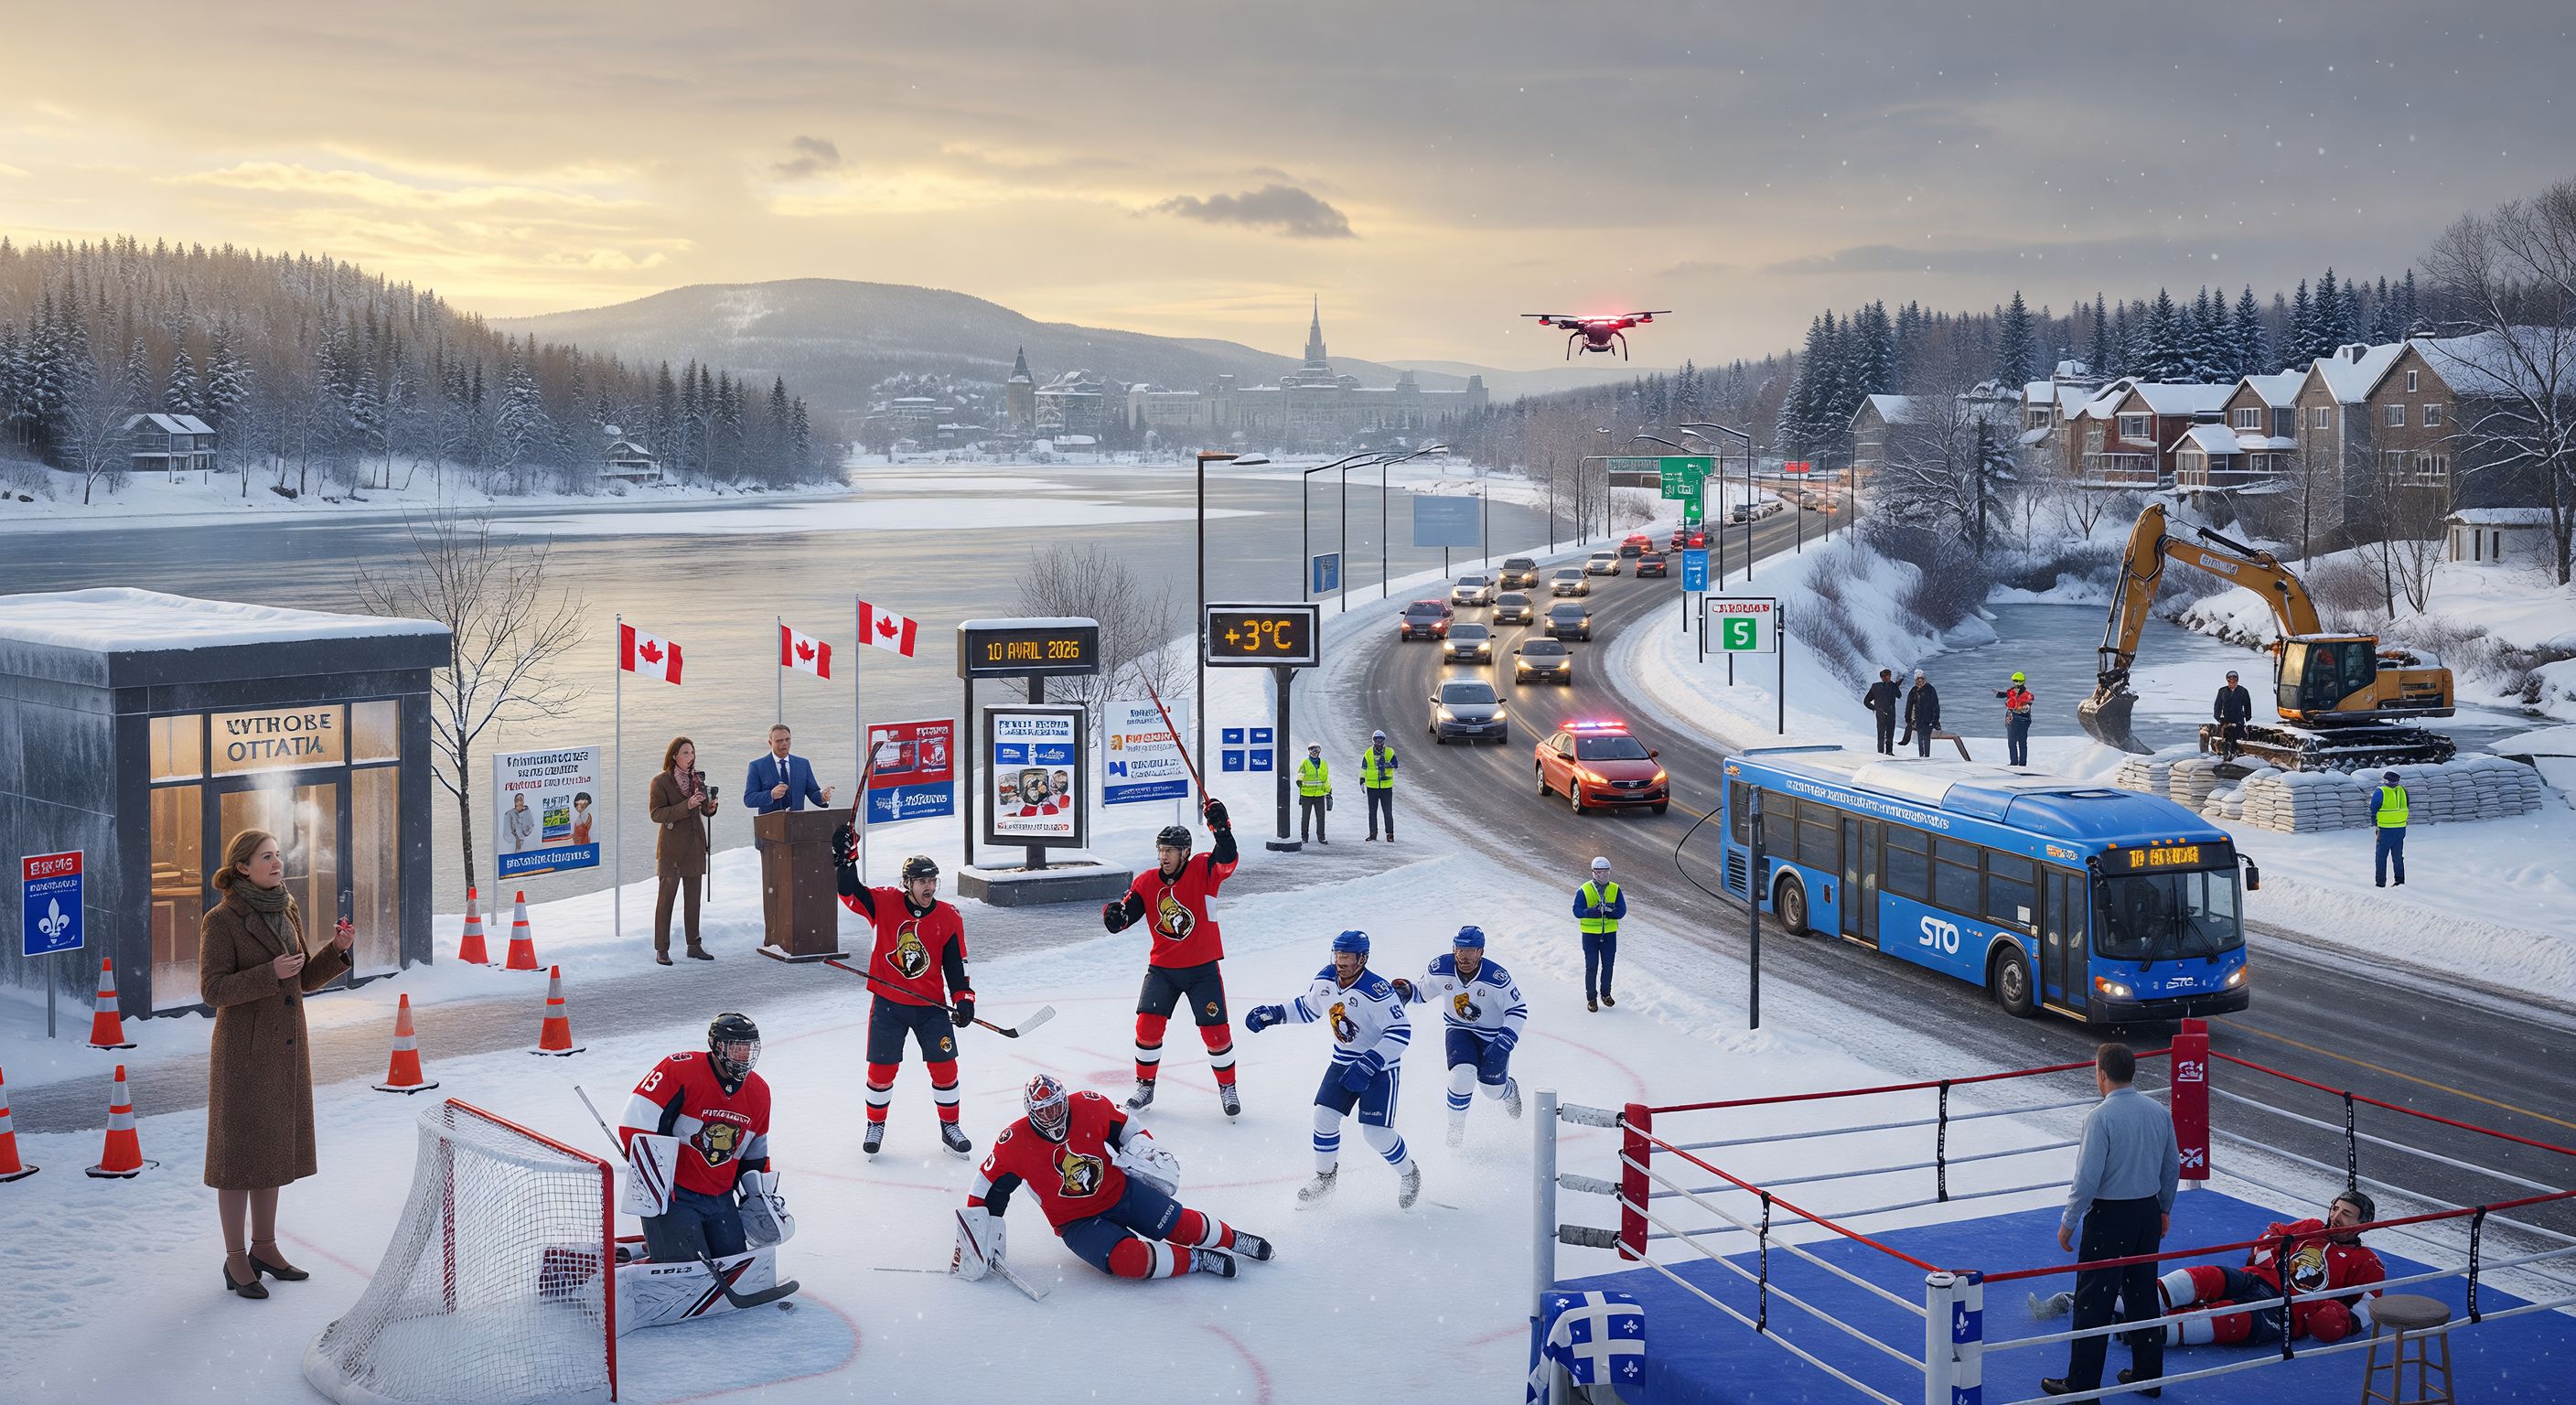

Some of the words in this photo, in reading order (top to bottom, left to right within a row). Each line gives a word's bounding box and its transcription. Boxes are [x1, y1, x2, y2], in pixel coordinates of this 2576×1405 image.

[987, 642, 1003, 660] 10
[1007, 641, 1043, 660] AVRIL
[1047, 640, 1079, 659] 2026
[1224, 619, 1293, 651] +3°C
[1919, 916, 1960, 954] STO
